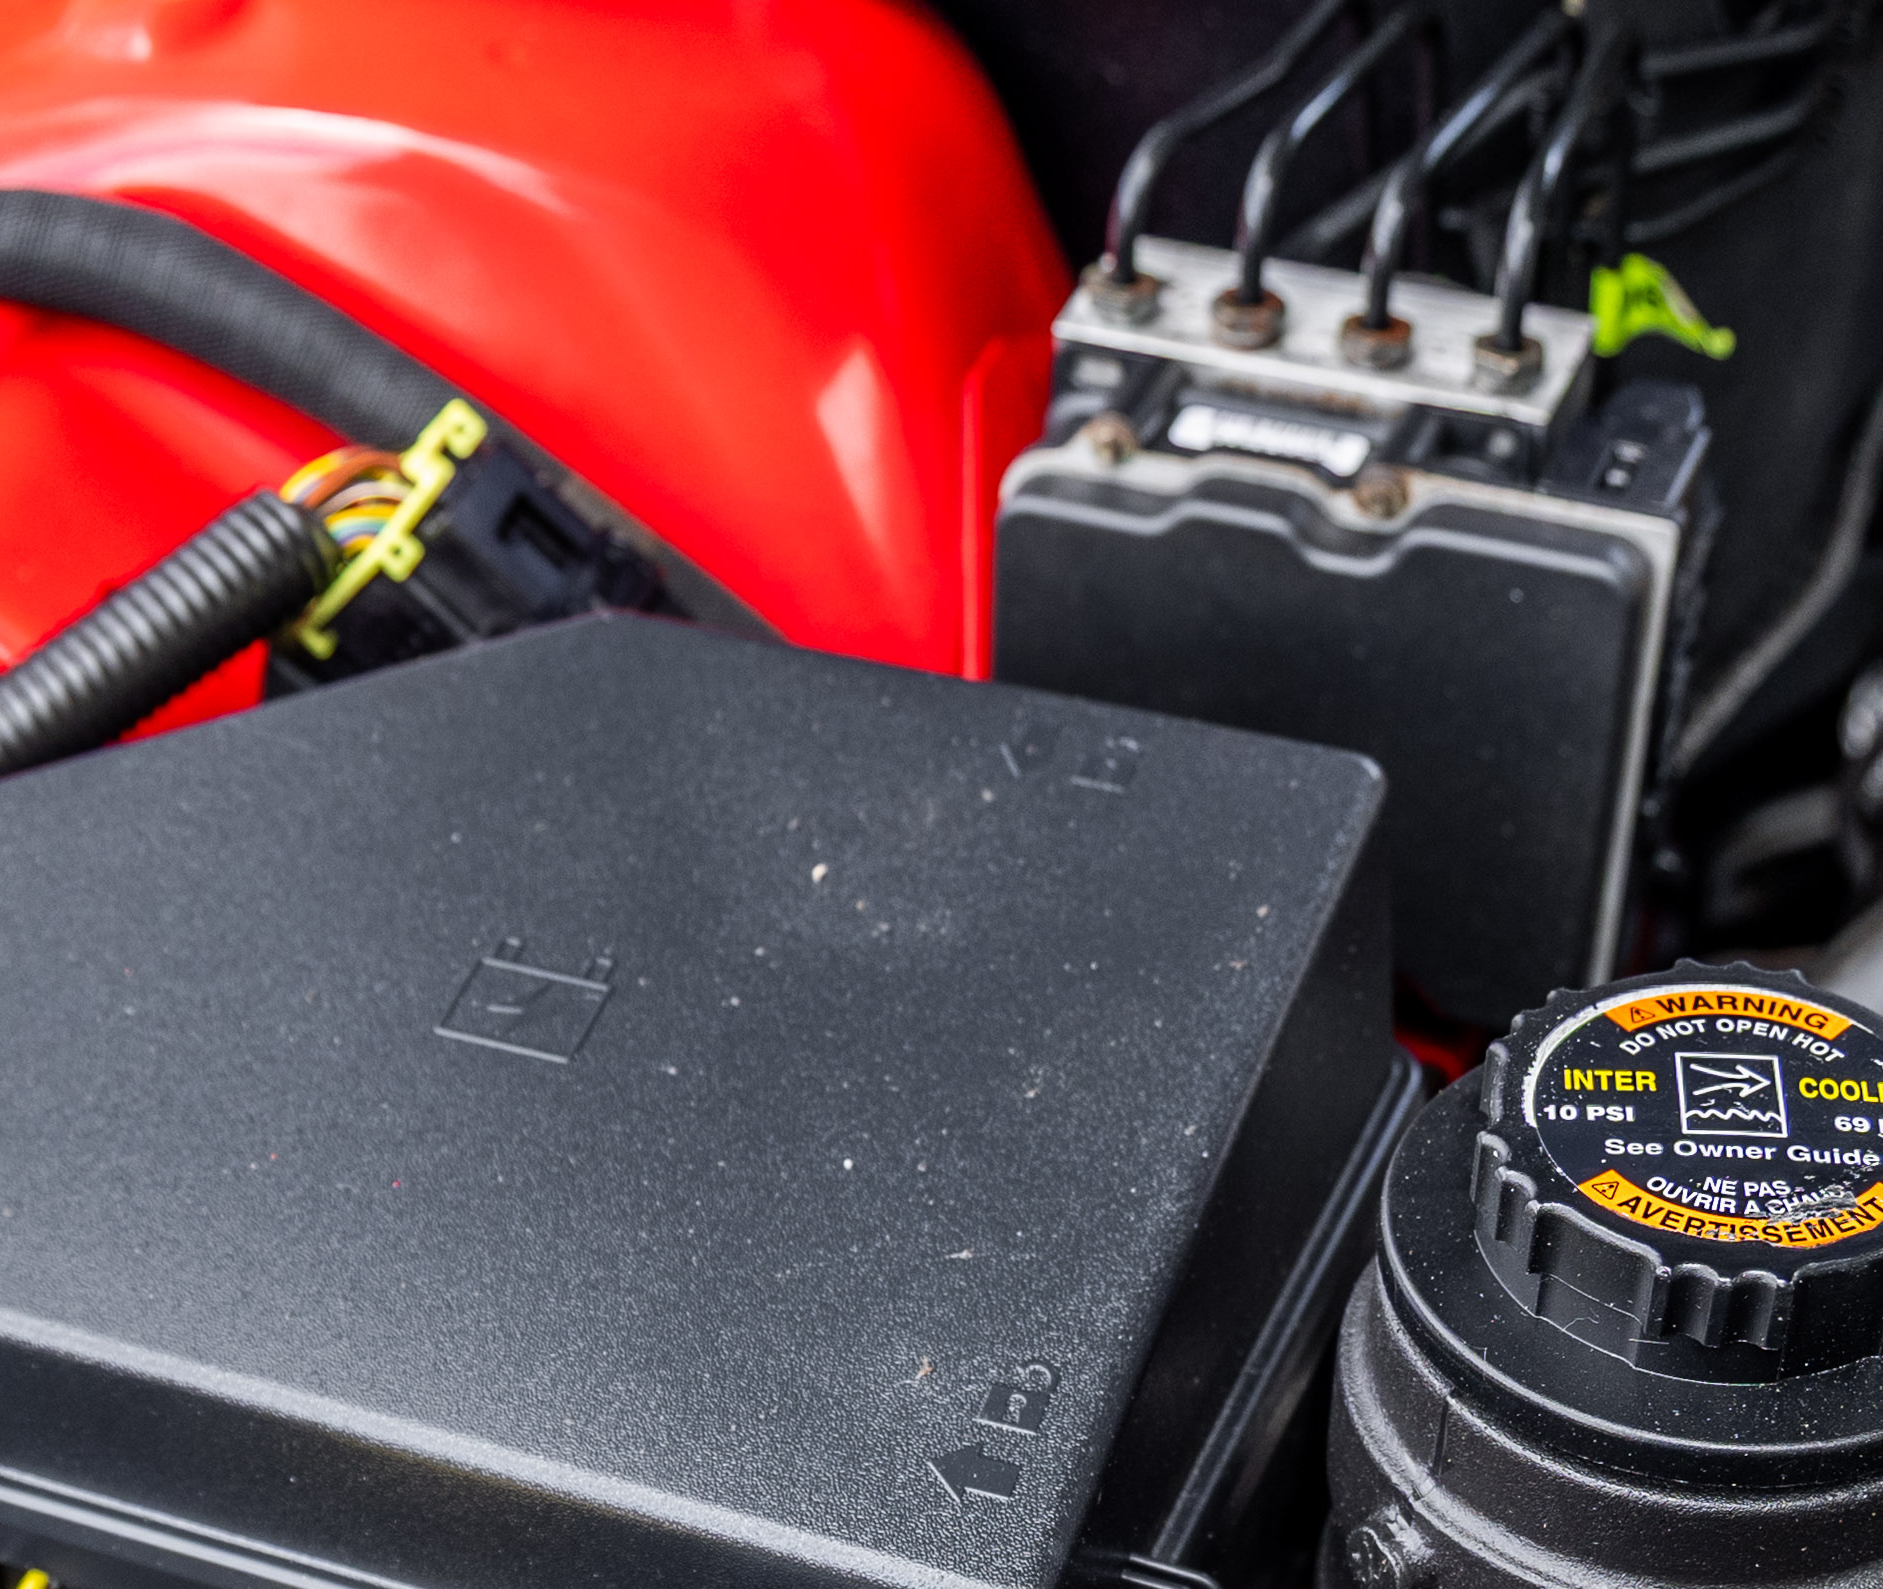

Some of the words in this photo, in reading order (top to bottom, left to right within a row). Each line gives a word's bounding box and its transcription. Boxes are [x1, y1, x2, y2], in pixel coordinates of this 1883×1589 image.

[1656, 995, 1830, 1031] WARNING
[1619, 1032, 1656, 1055] DO
[1656, 1018, 1706, 1040] NOT
[1715, 1018, 1788, 1041] OPEN
[1792, 1032, 1845, 1062] HOT
[1563, 1068, 1657, 1092] INTER
[1543, 1104, 1578, 1121] 10
[1586, 1105, 1636, 1122] PSI
[1834, 1116, 1871, 1133] 69
[1604, 1138, 1664, 1155] See
[1673, 1140, 1777, 1160] Owner
[1786, 1144, 1881, 1166] Guide
[1646, 1176, 1737, 1214] OUVRIR
[1702, 1176, 1737, 1197] NE
[1743, 1180, 1791, 1198] PAS
